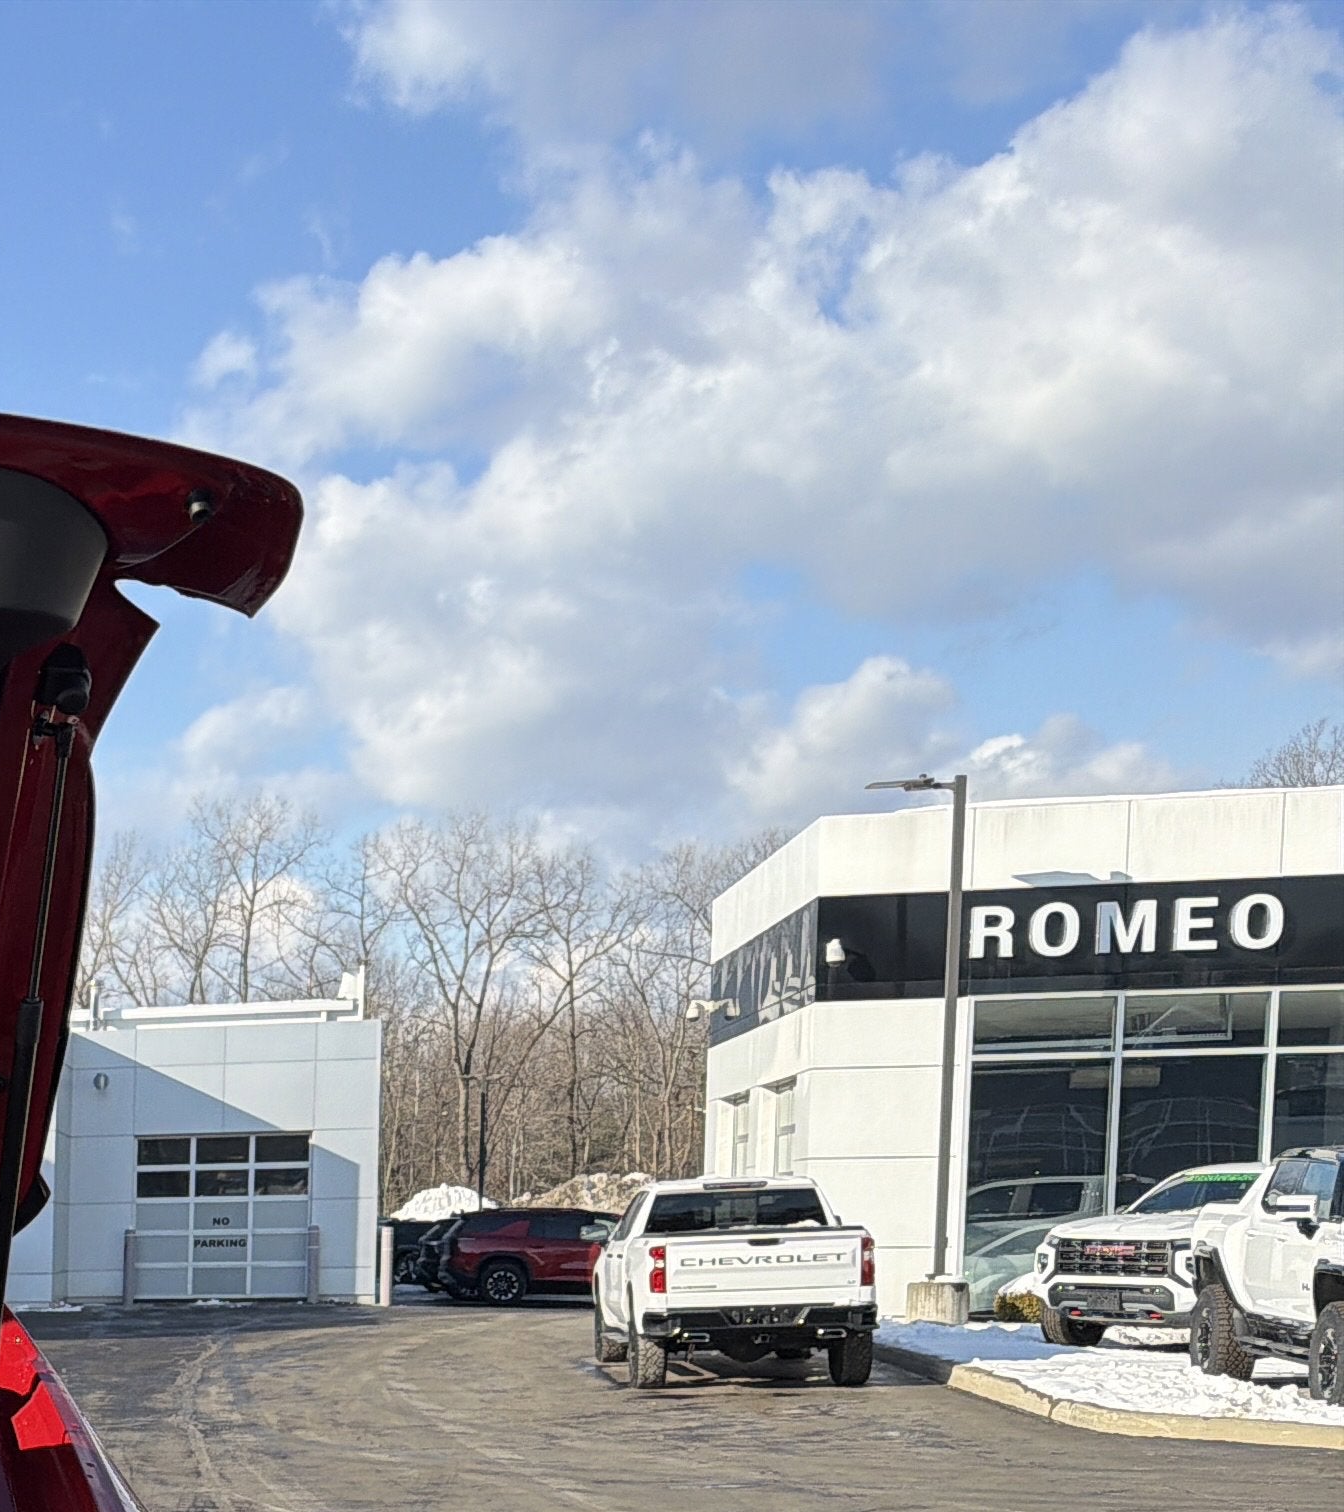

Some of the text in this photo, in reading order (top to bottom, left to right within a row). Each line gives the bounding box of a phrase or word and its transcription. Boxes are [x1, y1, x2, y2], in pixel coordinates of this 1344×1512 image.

[967, 893, 1285, 958] ROMEO
[212, 1217, 231, 1226] NO
[193, 1239, 247, 1248] PARKING
[680, 1252, 847, 1267] CHEVROLET
